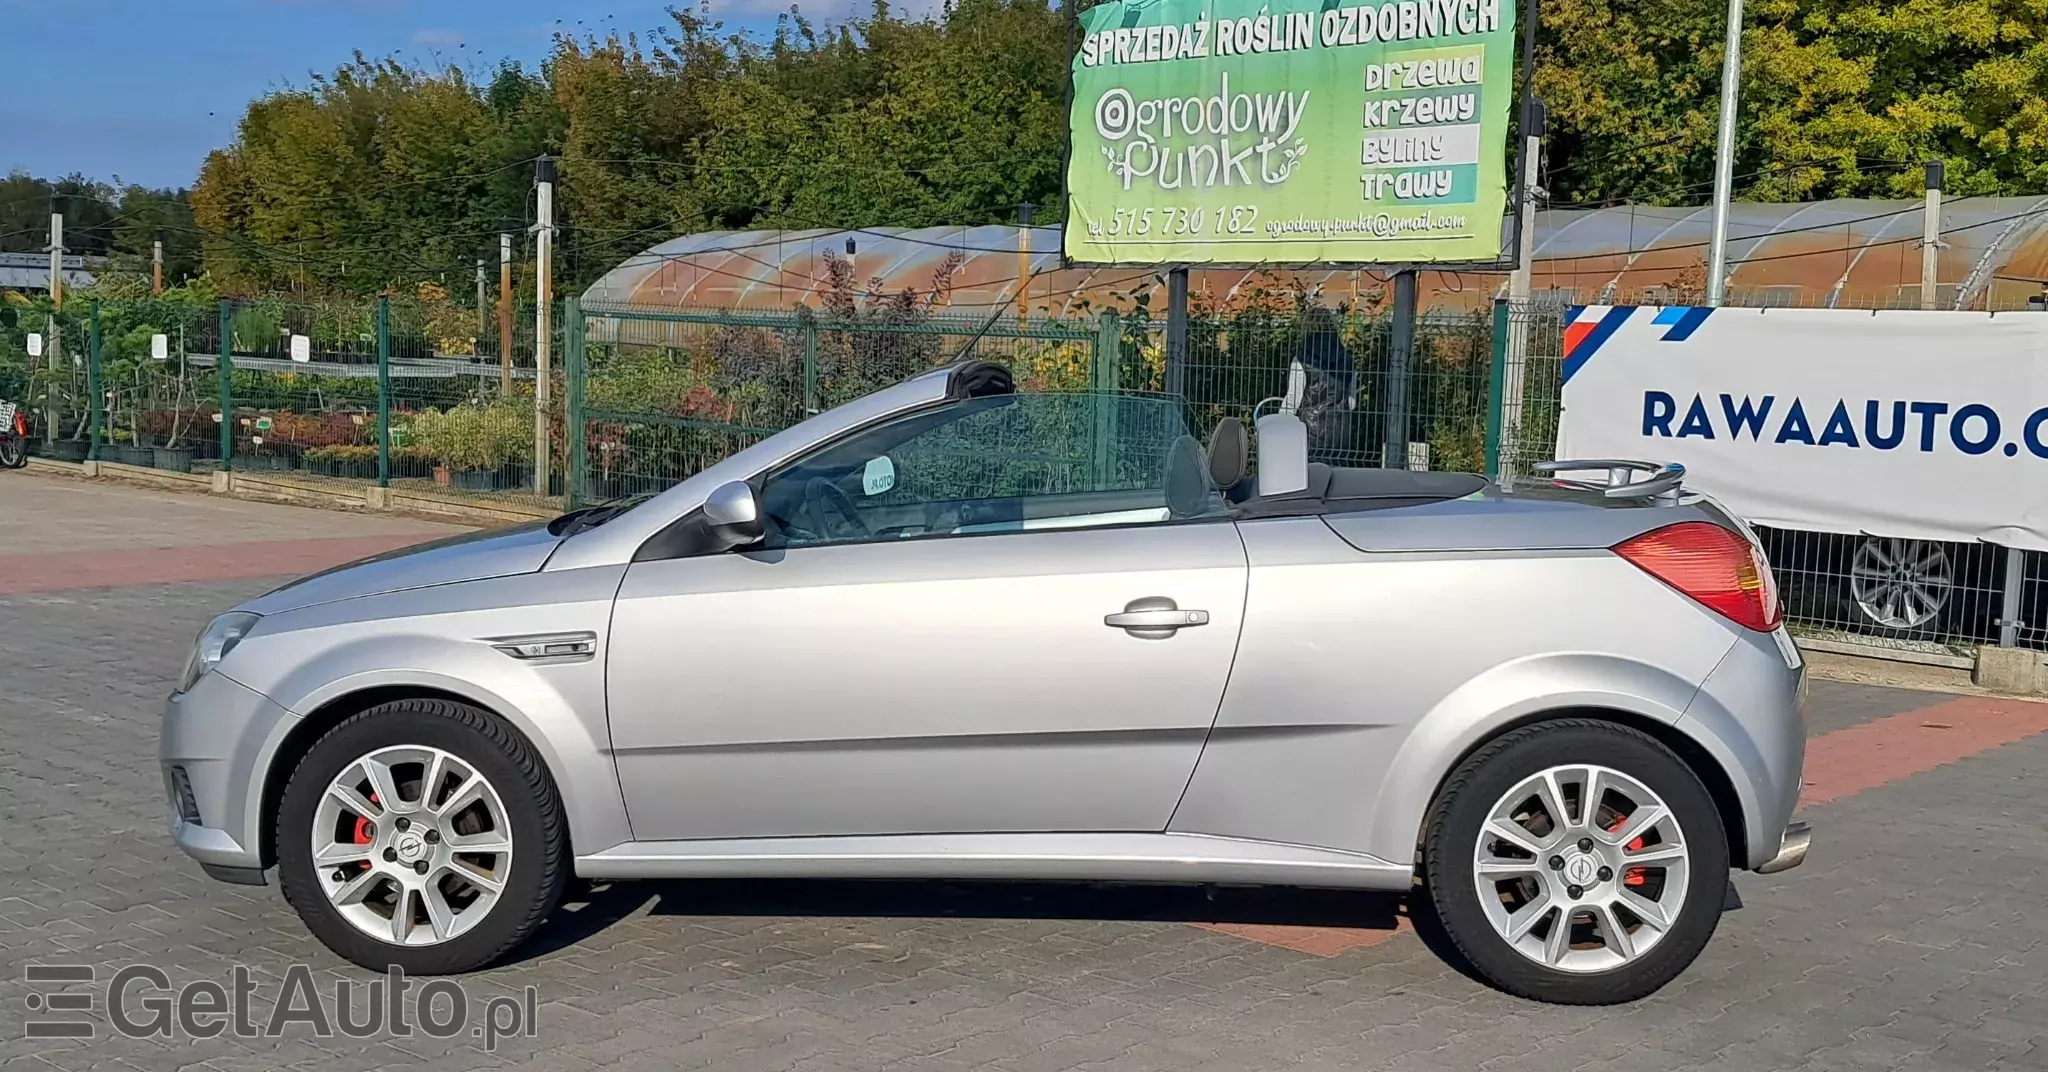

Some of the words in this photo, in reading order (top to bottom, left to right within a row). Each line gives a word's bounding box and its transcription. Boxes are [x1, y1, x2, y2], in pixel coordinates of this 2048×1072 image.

[1082, 11, 1211, 68] SPRZEDAŻ
[1215, 4, 1314, 56] ROŚLIN
[1320, 0, 1499, 48] OZDOBNYCH
[1095, 71, 1311, 144] Ogrodowy
[1107, 207, 1155, 236] 515
[1161, 206, 1204, 235] 730
[1214, 205, 1258, 234] 182
[1265, 210, 1467, 239] ogrodowy.punkt@gmail.com
